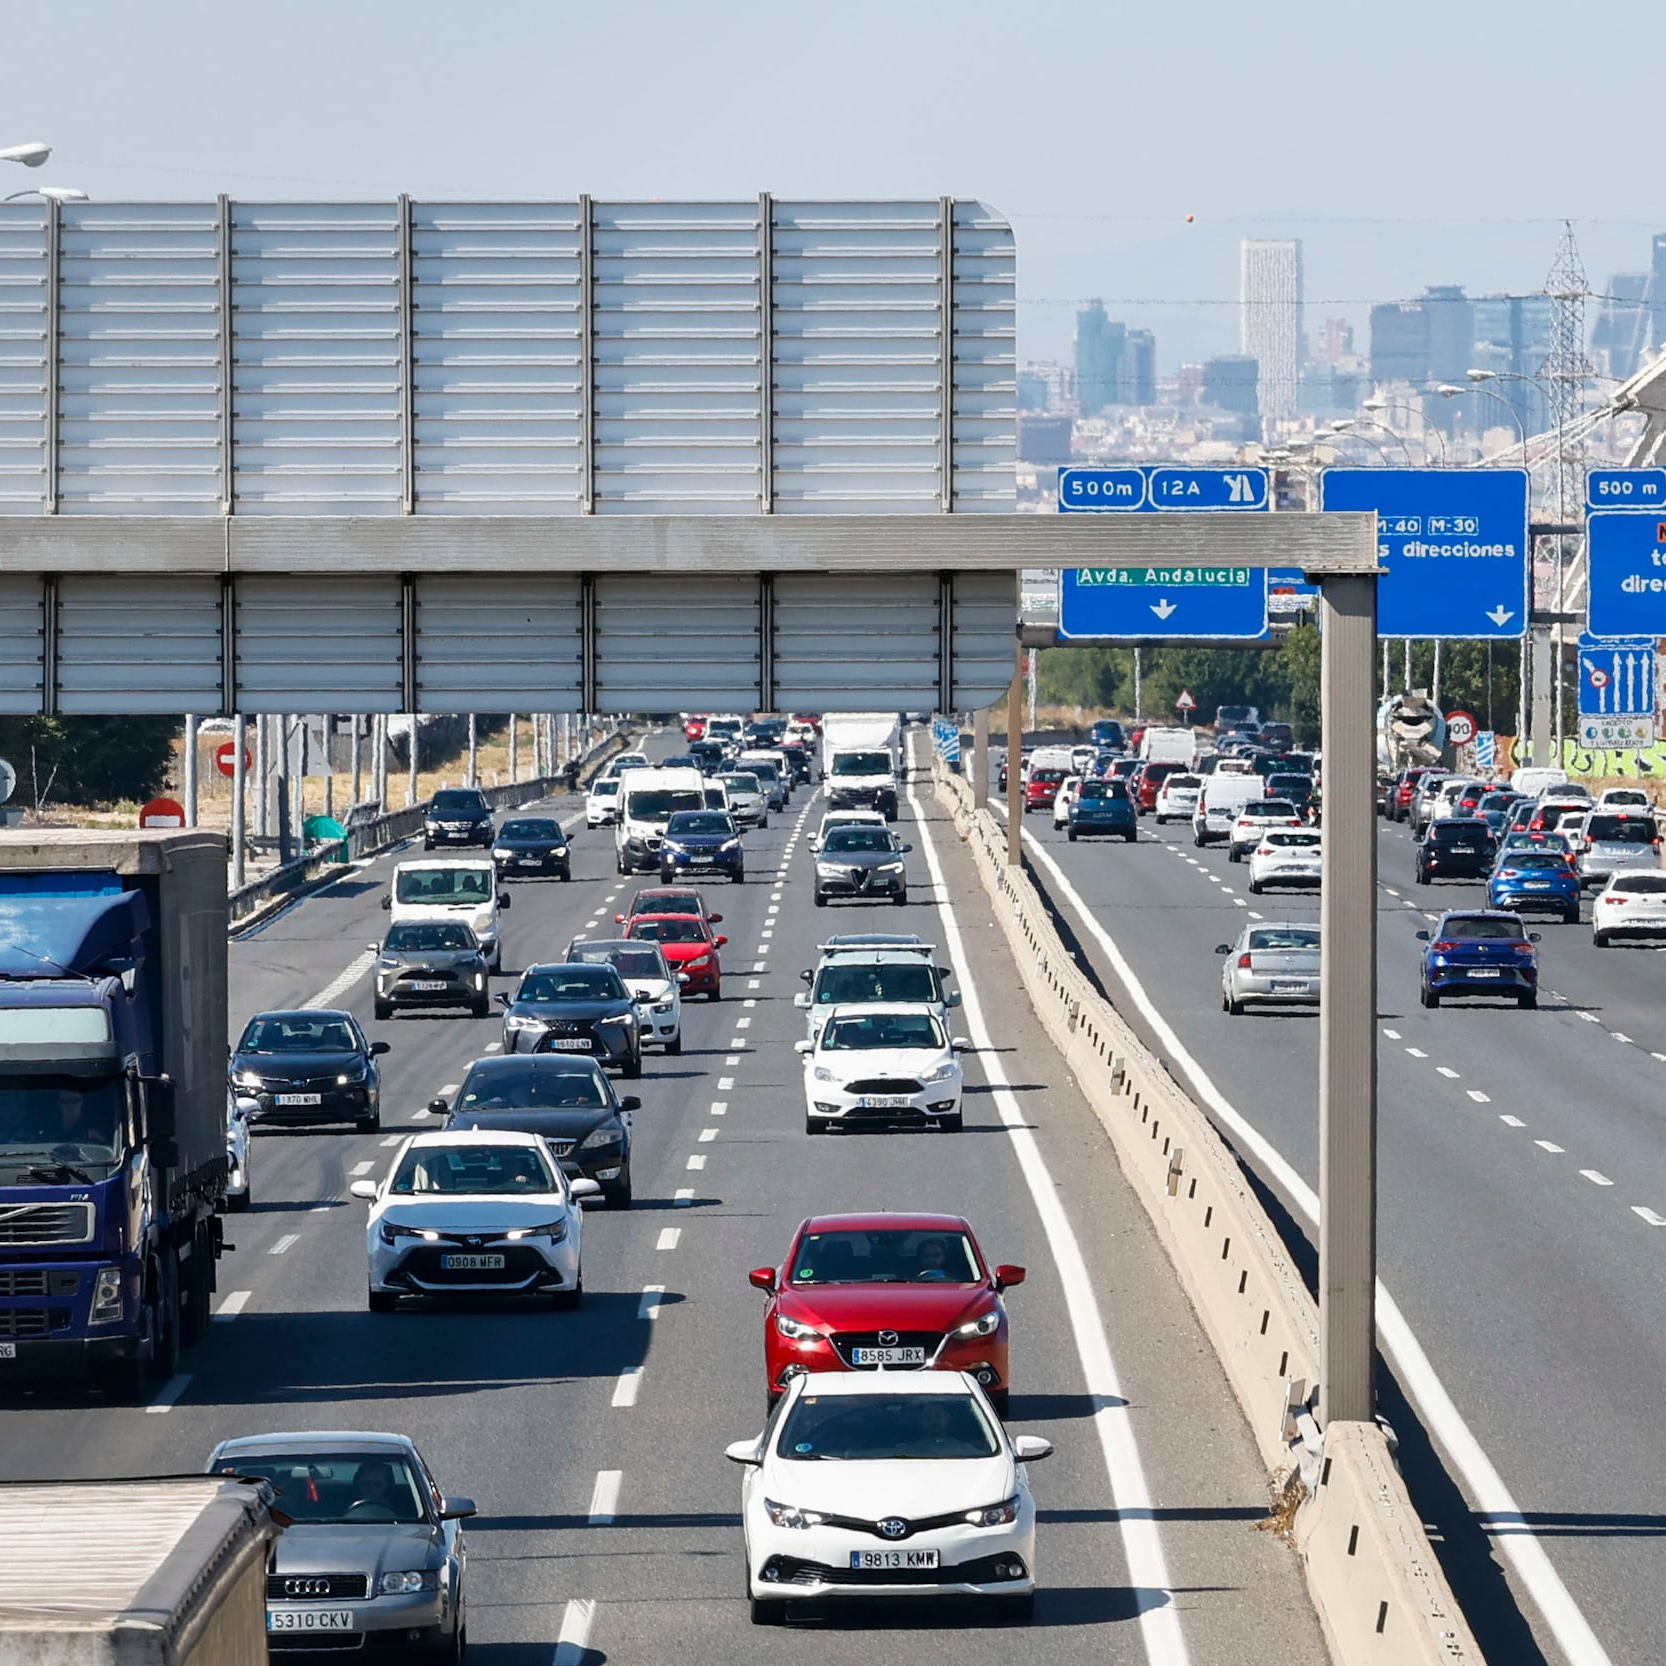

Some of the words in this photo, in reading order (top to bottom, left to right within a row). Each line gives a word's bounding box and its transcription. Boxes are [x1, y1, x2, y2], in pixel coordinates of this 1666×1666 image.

[1162, 481, 1200, 495] 12A
[1599, 481, 1633, 495] 500
[1643, 483, 1657, 495] m
[1431, 519, 1476, 533] M-30
[1403, 541, 1515, 557] direcciones
[448, 1256, 477, 1268] 0908
[861, 1349, 892, 1363] 8585
[897, 1348, 923, 1362] JRX
[864, 1554, 900, 1568] 9813
[907, 1552, 935, 1566] KMW
[275, 1614, 314, 1628] 5310
[319, 1612, 349, 1627] CKV
